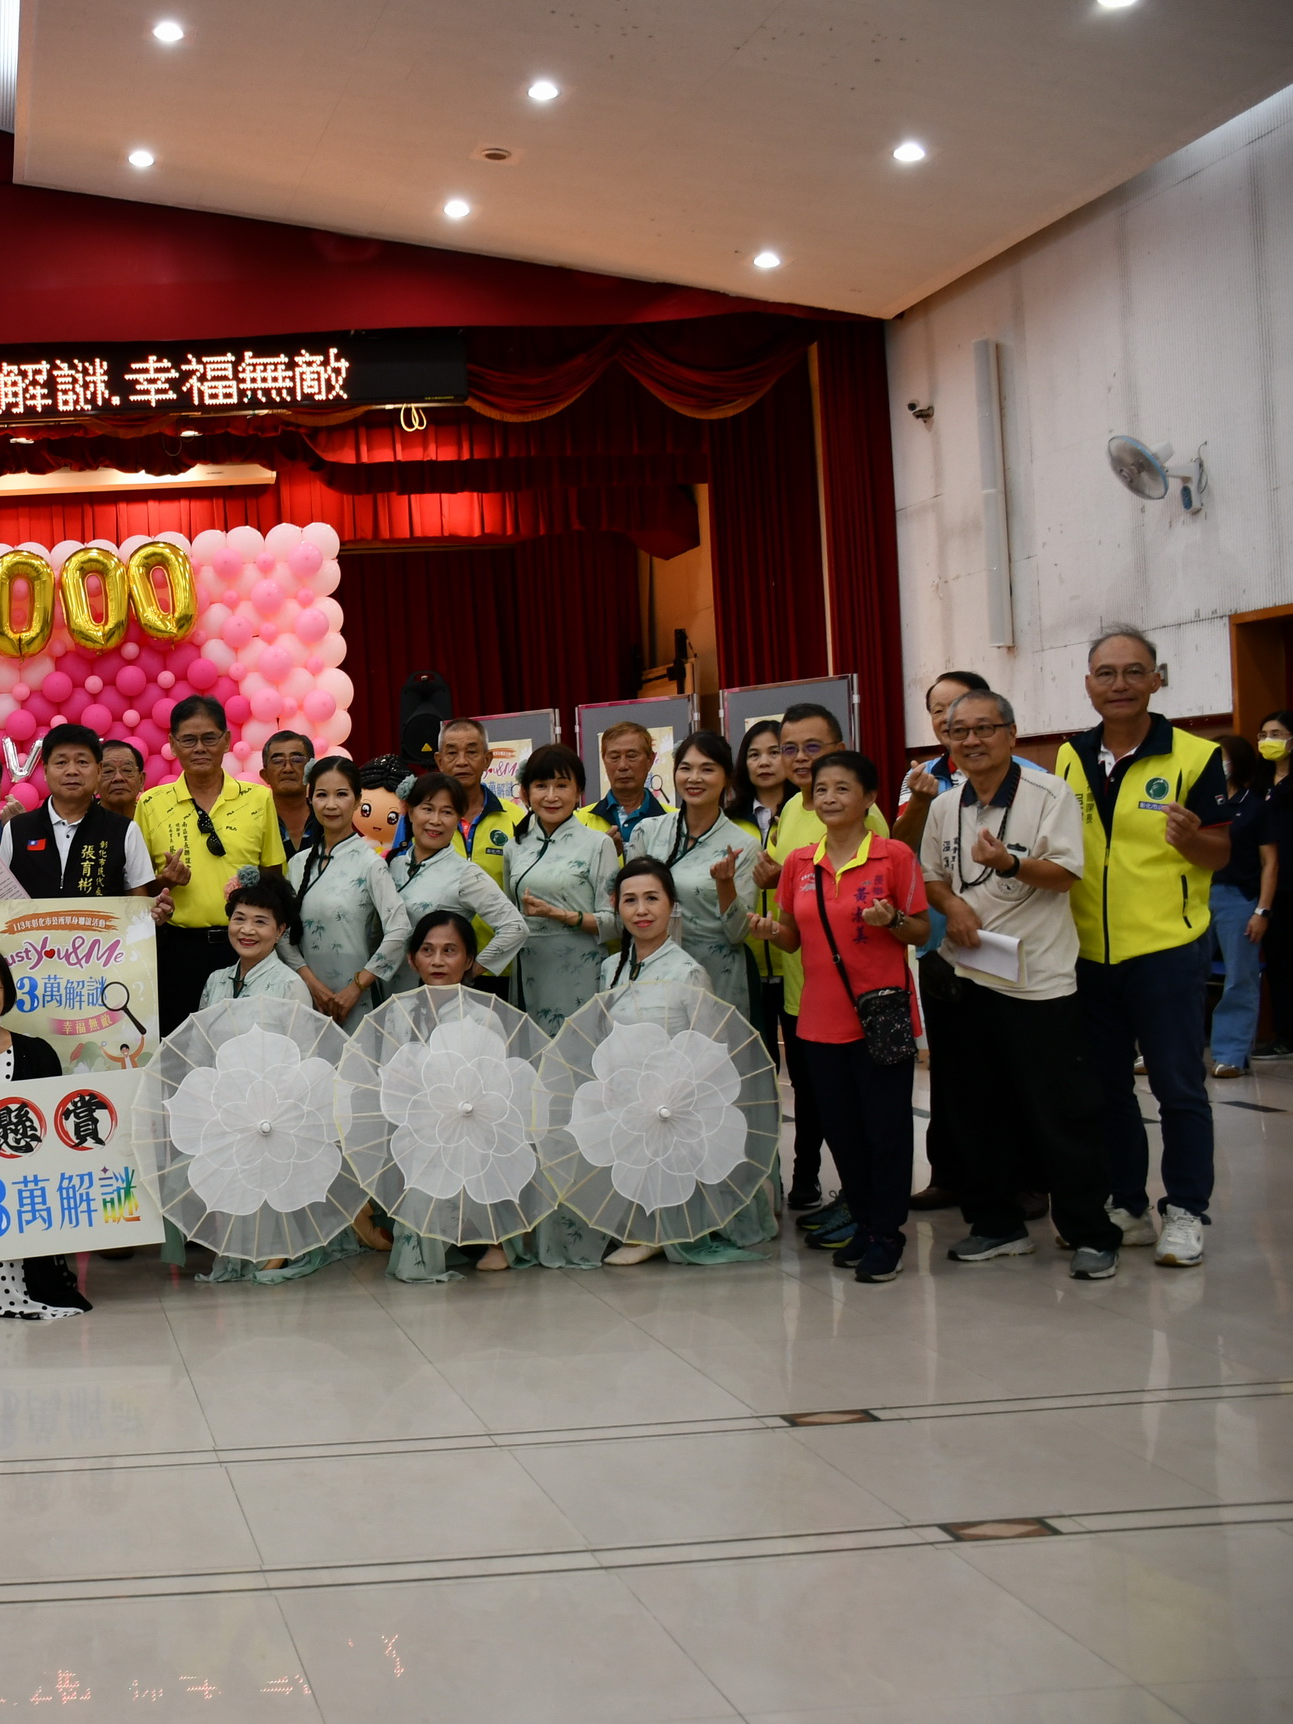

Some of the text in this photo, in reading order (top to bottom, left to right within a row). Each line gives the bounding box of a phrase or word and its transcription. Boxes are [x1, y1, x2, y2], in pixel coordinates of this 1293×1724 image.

[77, 844, 96, 894] 張育彬
[95, 840, 108, 896] 彰化市民代表
[62, 1014, 112, 1034] 幸福無敵
